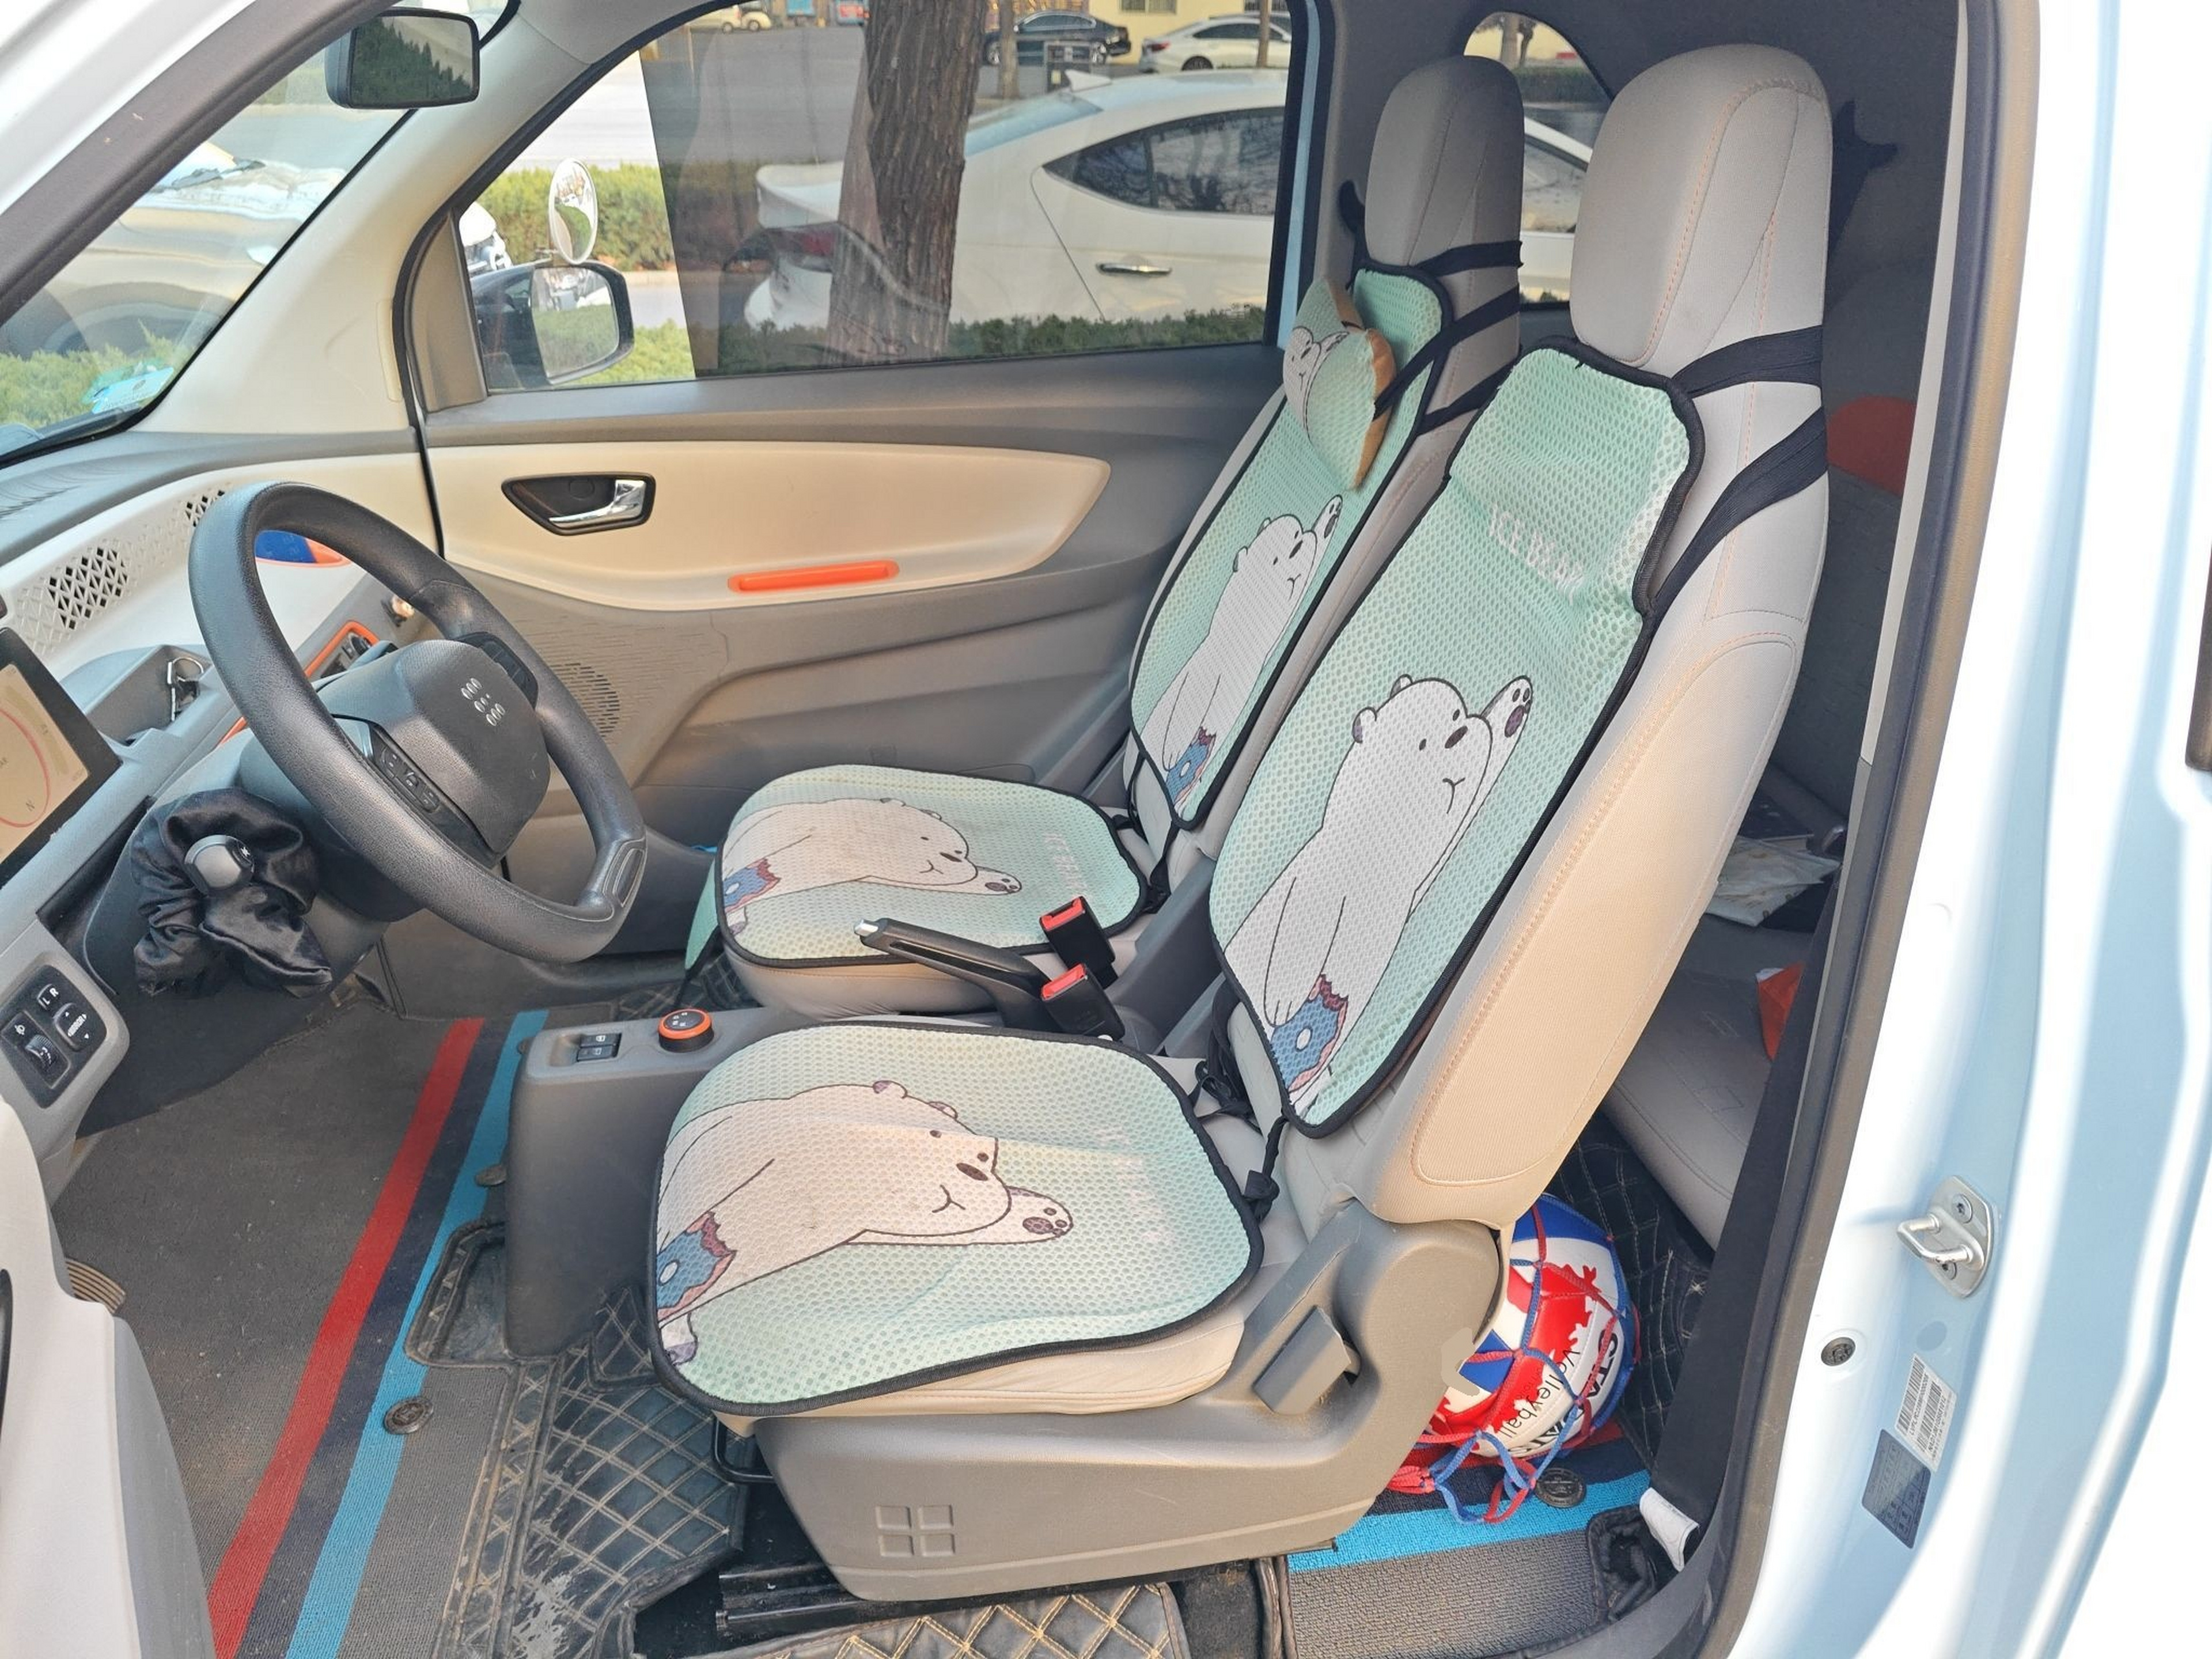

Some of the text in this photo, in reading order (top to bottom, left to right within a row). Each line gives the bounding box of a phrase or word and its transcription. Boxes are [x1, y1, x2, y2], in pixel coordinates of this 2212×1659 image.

[42, 987, 59, 1005] L R
[1497, 1349, 1581, 1439] Volleyball
